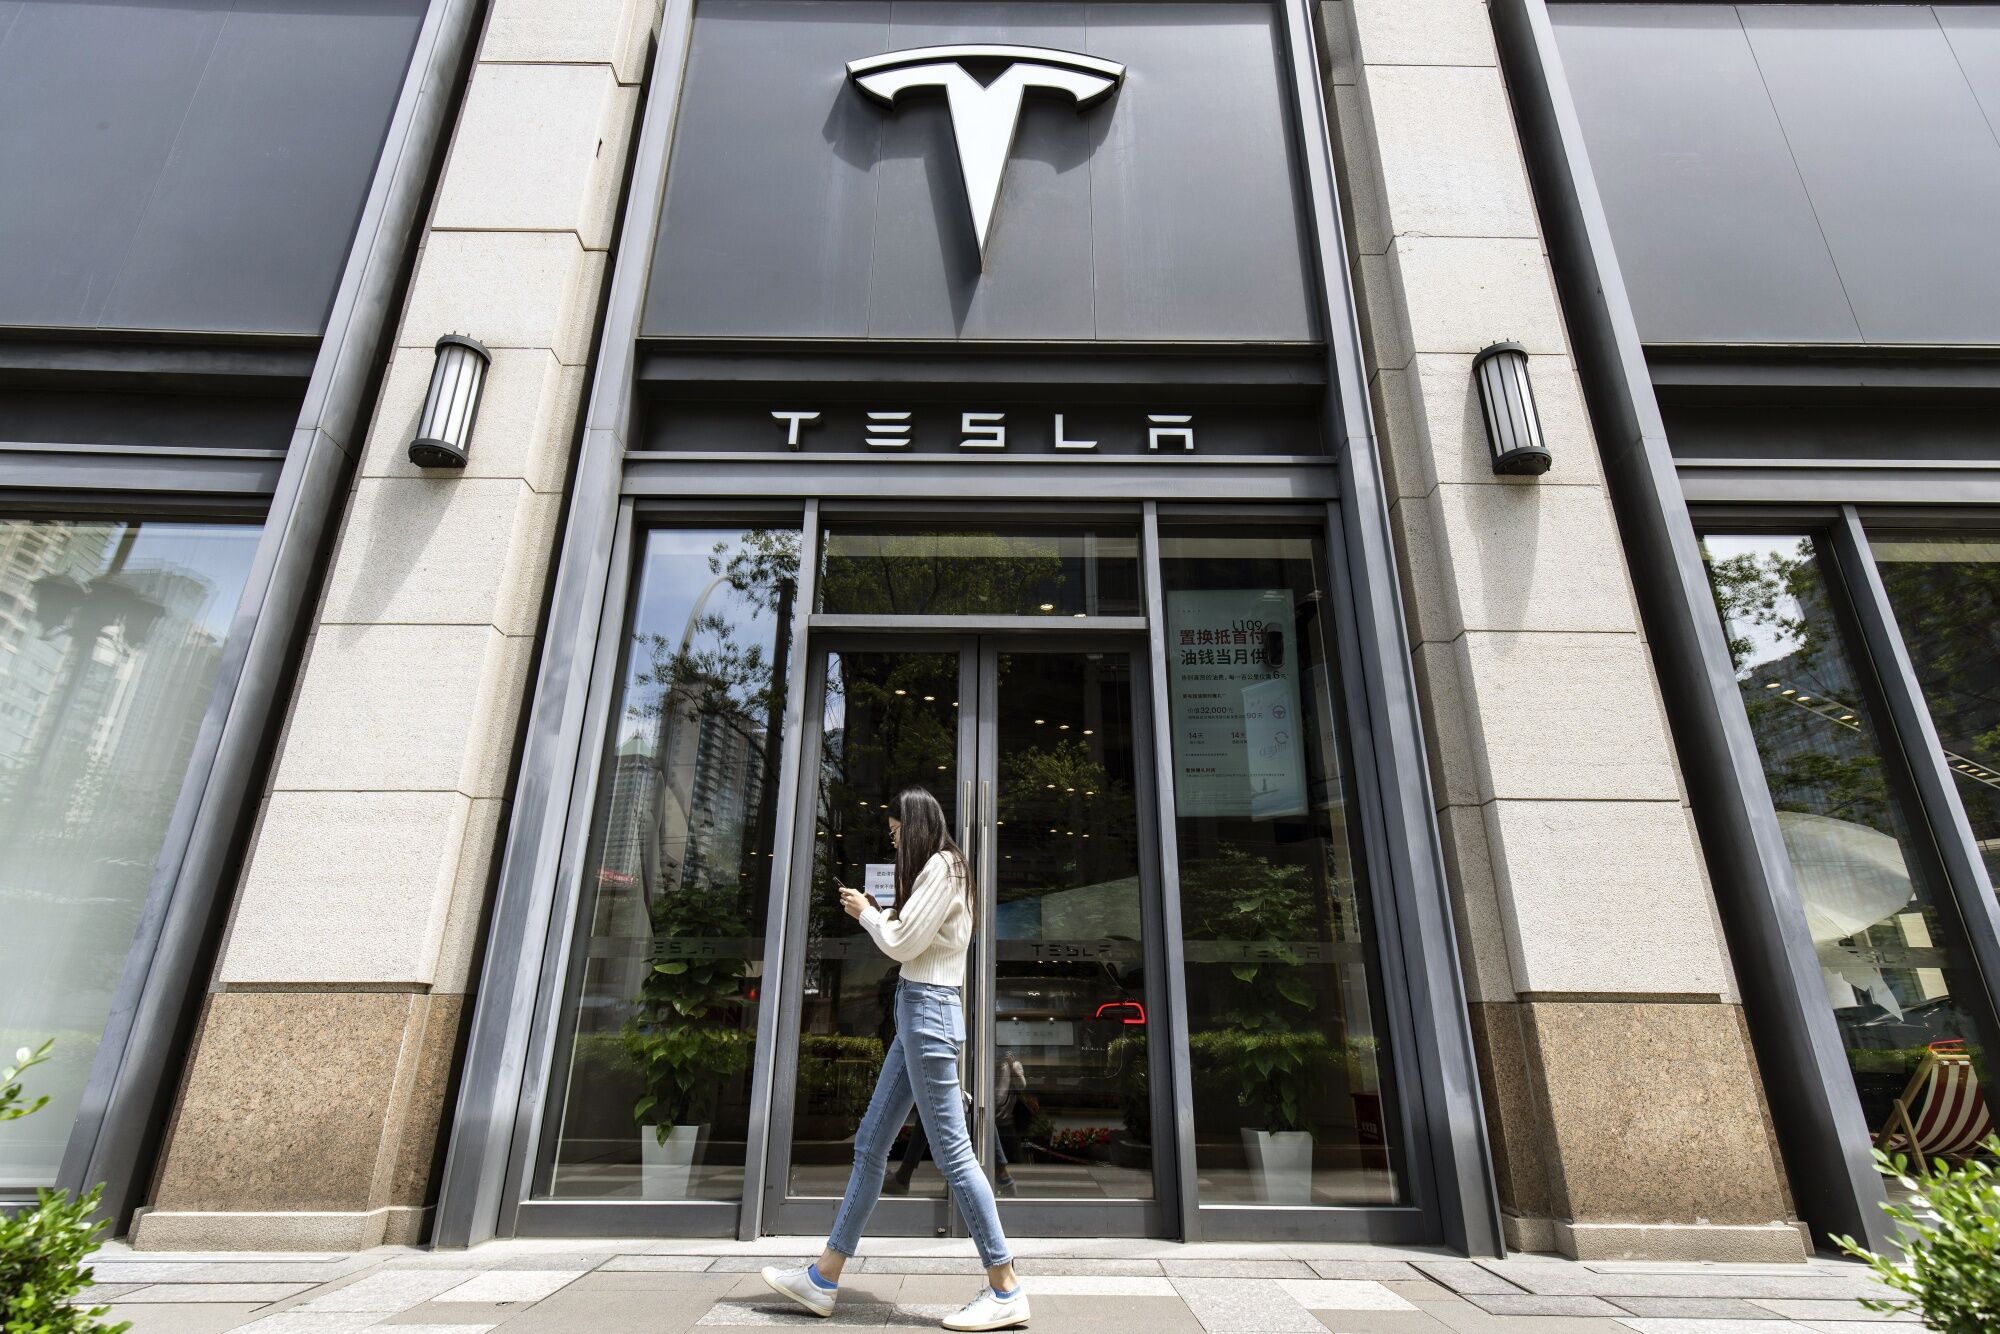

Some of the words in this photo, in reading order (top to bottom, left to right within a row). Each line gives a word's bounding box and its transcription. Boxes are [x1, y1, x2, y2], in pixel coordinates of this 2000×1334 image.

[770, 411, 1195, 451] TESLA
[1179, 629, 1264, 645] 置换抵首付
[1180, 649, 1268, 665] 油钱当月供
